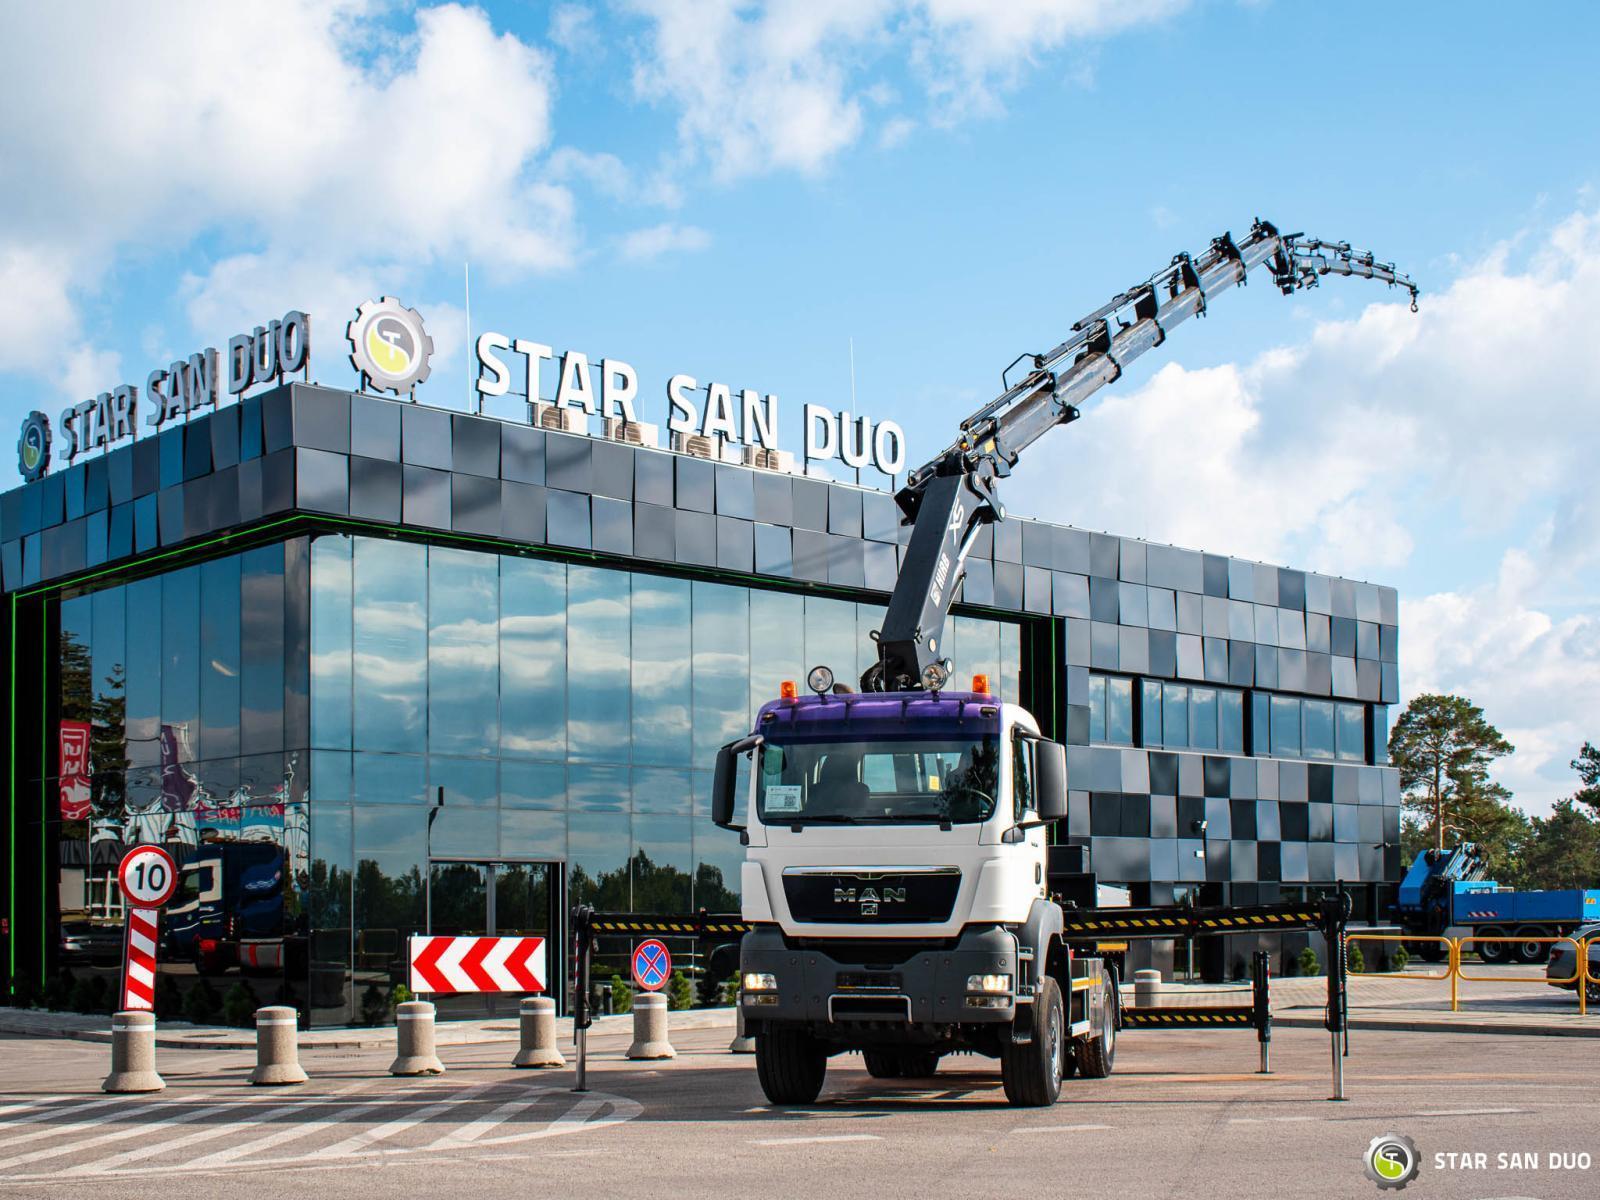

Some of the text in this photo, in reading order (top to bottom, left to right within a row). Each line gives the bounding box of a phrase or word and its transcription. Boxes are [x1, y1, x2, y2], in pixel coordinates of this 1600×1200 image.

[59, 310, 309, 460] STAR SAN DUO
[475, 331, 905, 475] STAR SAN DUO
[135, 861, 166, 892] 10
[834, 887, 906, 902] MAN
